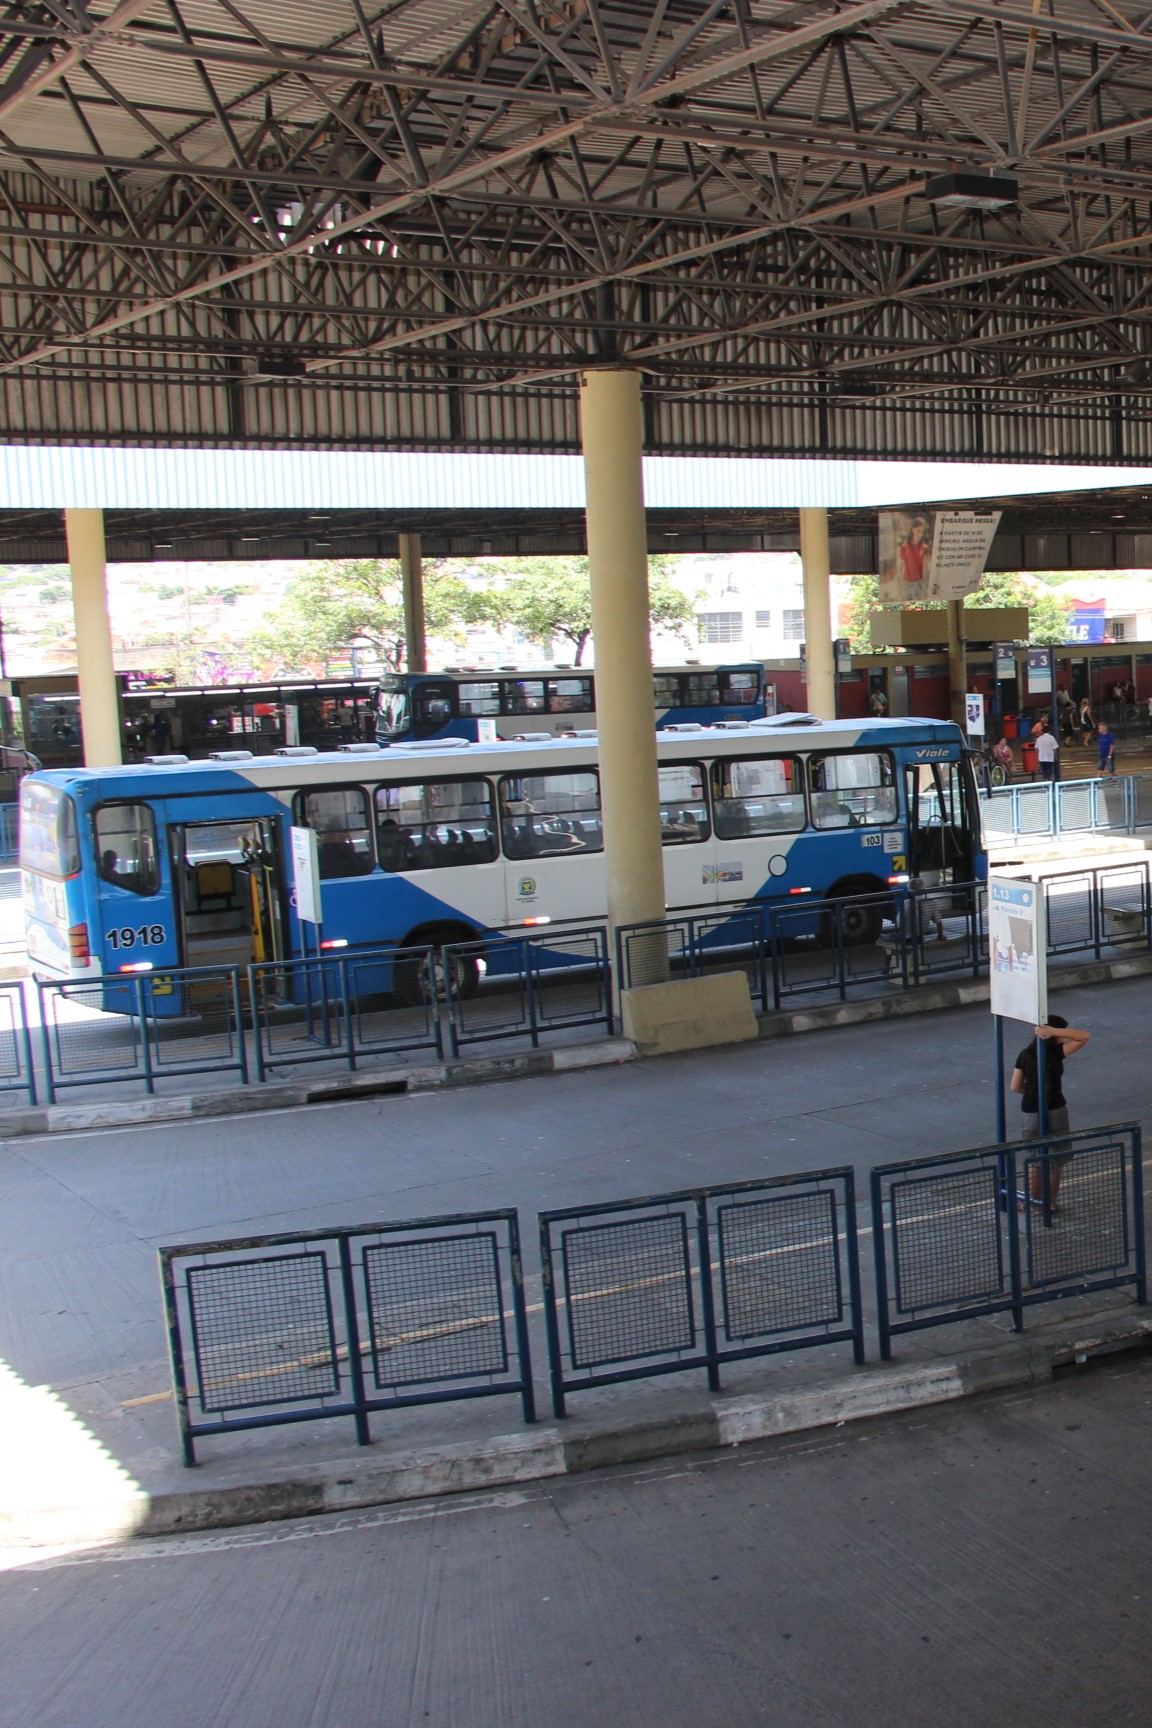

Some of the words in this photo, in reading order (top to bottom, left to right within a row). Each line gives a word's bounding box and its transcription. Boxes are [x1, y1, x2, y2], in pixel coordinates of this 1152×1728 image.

[998, 648, 1005, 657] 2
[1040, 655, 1048, 666] 3
[916, 749, 949, 757] Viale
[866, 836, 880, 846] 103
[993, 887, 1009, 900] 1.13
[106, 924, 166, 949] 1918
